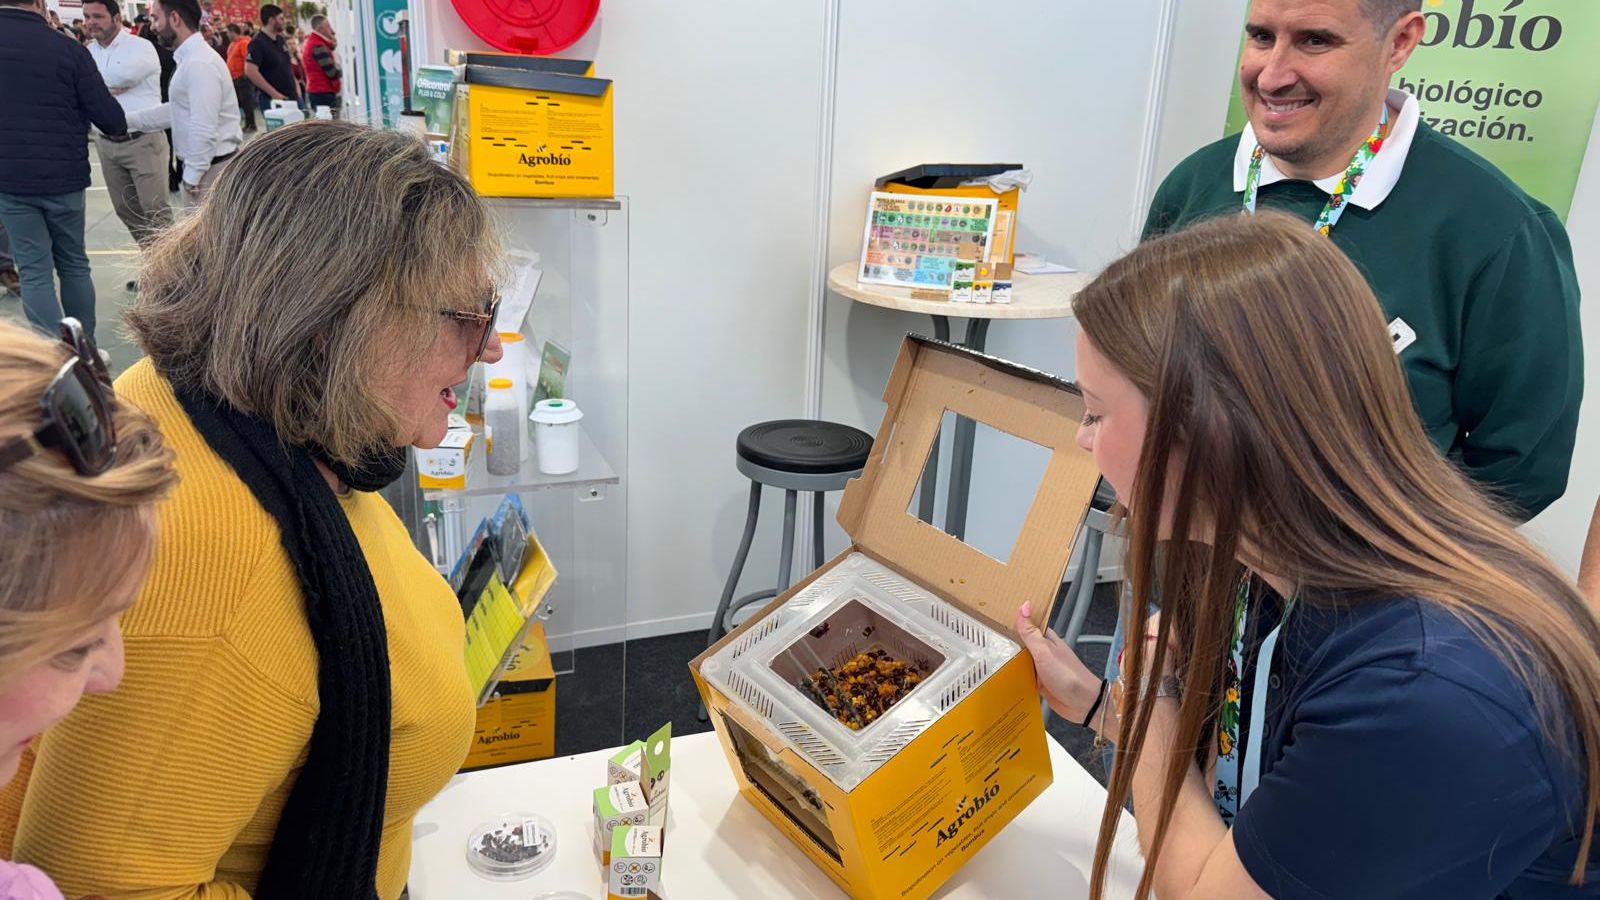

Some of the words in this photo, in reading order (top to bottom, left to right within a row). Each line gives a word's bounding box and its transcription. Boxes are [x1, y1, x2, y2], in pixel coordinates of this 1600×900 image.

[1398, 77, 1543, 111] biológico
[518, 152, 572, 168] Agrobío
[936, 783, 1000, 849] Agrobío
